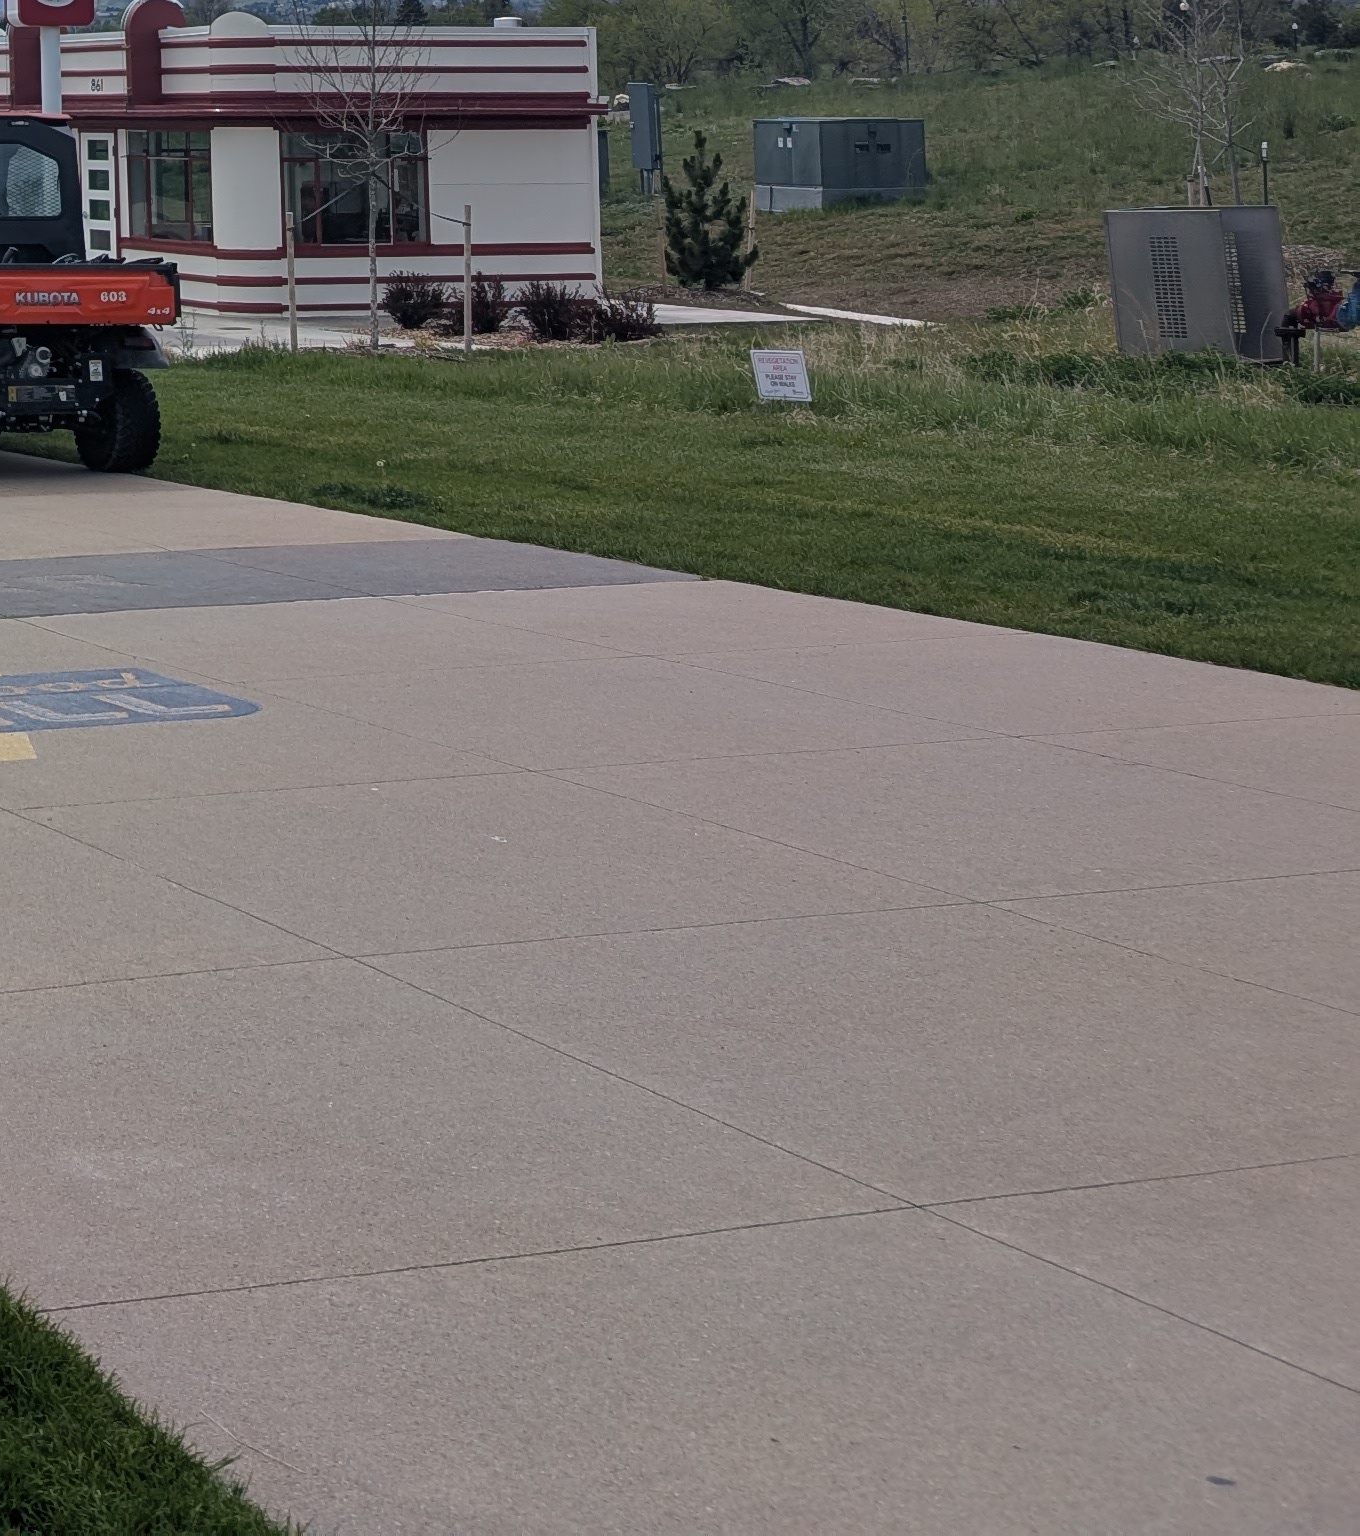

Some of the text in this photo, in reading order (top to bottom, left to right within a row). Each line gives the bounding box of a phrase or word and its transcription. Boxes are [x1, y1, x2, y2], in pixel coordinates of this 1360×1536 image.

[91, 78, 104, 92] 861
[15, 291, 80, 305] KUBOTA
[147, 306, 171, 315] 4x4
